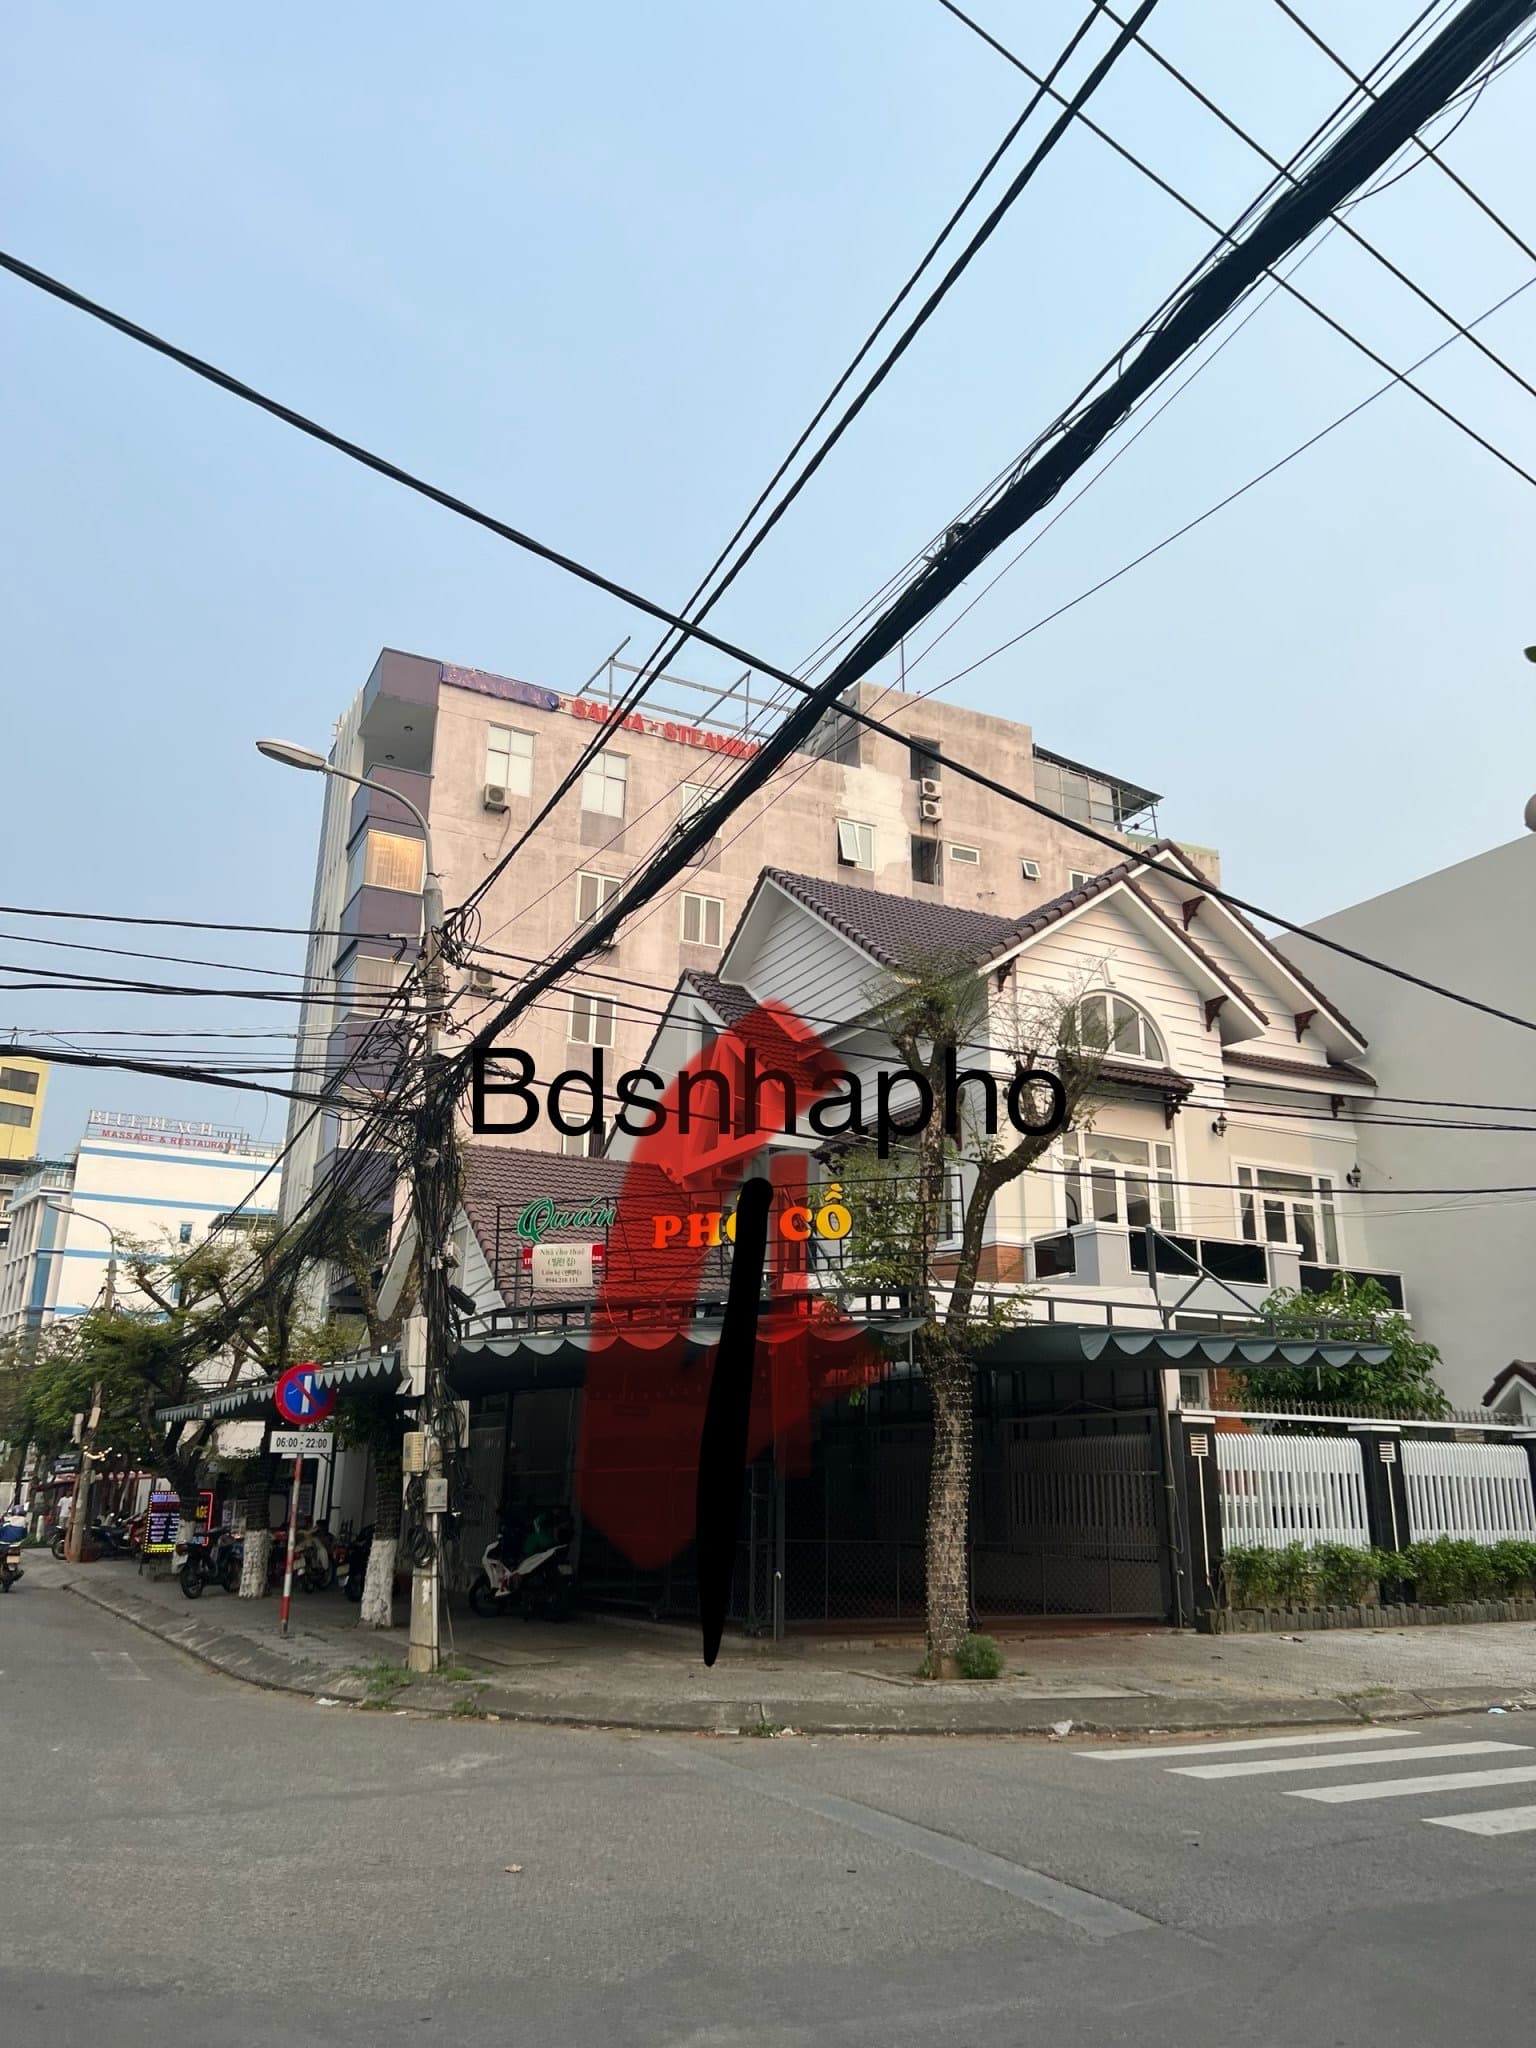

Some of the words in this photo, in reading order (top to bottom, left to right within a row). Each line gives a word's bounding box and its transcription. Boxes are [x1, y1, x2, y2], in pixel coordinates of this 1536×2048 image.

[91, 1110, 140, 1129] BLUE
[149, 1116, 213, 1134] BEACH
[102, 1129, 154, 1142] MASSAGE
[160, 1136, 166, 1144] &
[170, 1137, 239, 1151] RESTAURANT
[517, 1196, 617, 1244] Quán
[652, 1194, 739, 1249] PH
[276, 1437, 298, 1448] 06:00
[305, 1438, 328, 1449] 22:00
